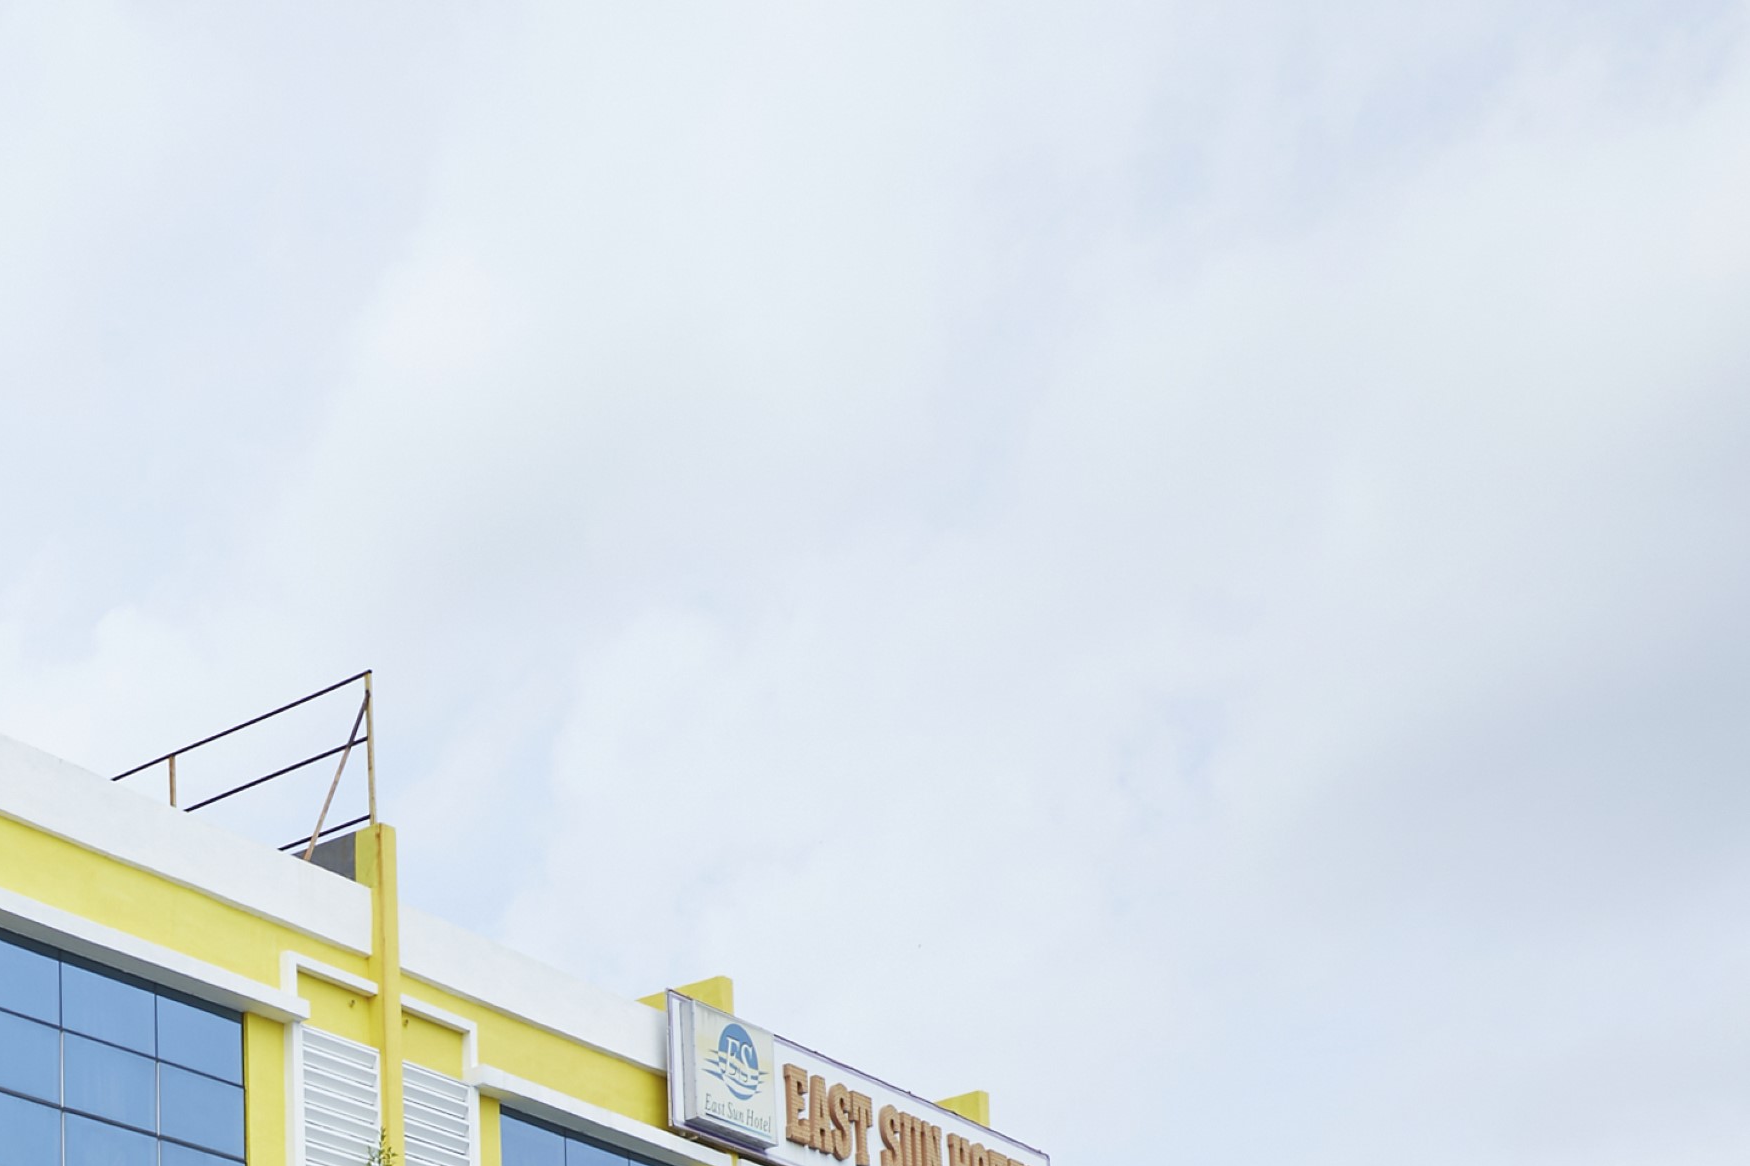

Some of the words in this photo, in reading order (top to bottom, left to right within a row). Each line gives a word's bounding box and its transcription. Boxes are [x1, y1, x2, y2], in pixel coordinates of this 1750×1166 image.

[705, 1093, 726, 1113] East
[728, 1102, 744, 1122] Sun
[746, 1109, 772, 1133] Hotel
